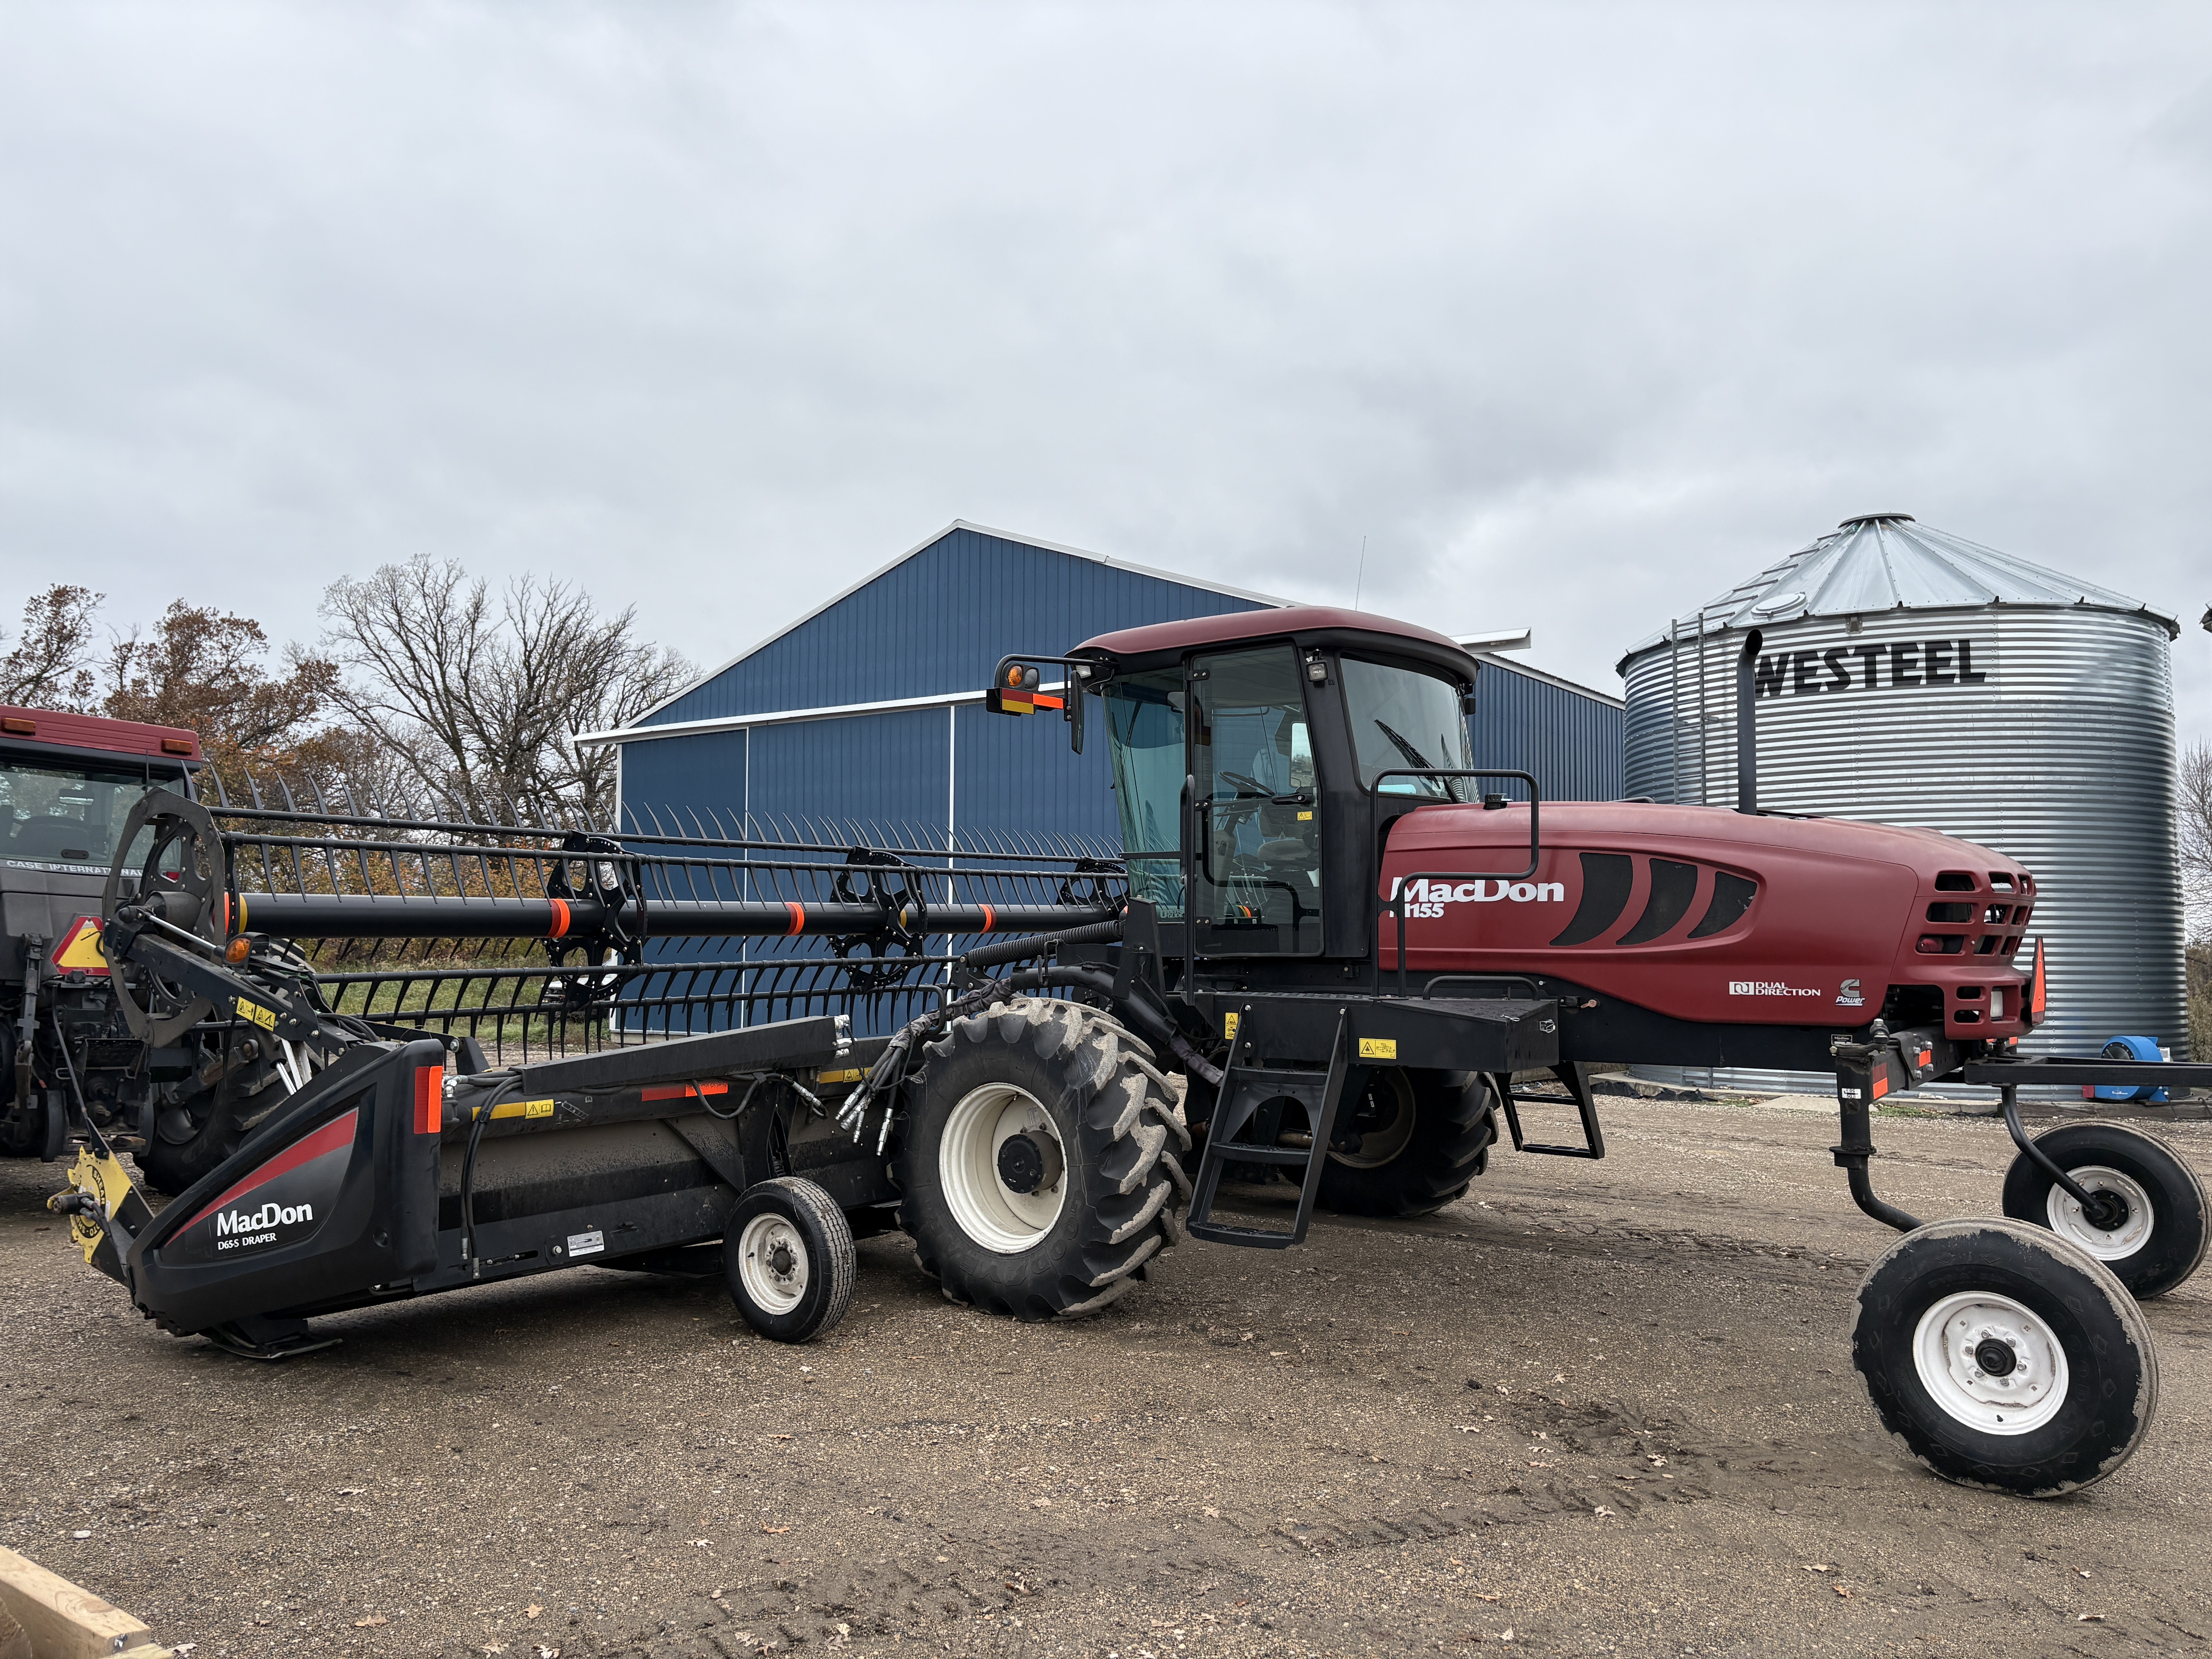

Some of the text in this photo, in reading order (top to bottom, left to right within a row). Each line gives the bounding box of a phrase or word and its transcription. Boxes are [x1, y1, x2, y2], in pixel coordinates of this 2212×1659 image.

[1755, 640, 1986, 697] WESTEEL
[7, 860, 143, 876] CASE INTERNATNAL
[1389, 877, 1564, 903] MacDon
[93, 1170, 105, 1205] SHEAR
[217, 1203, 313, 1236] MacDon
[218, 1233, 277, 1250] D65-S DRAPER
[928, 1192, 1085, 1286] GOODYEAR
